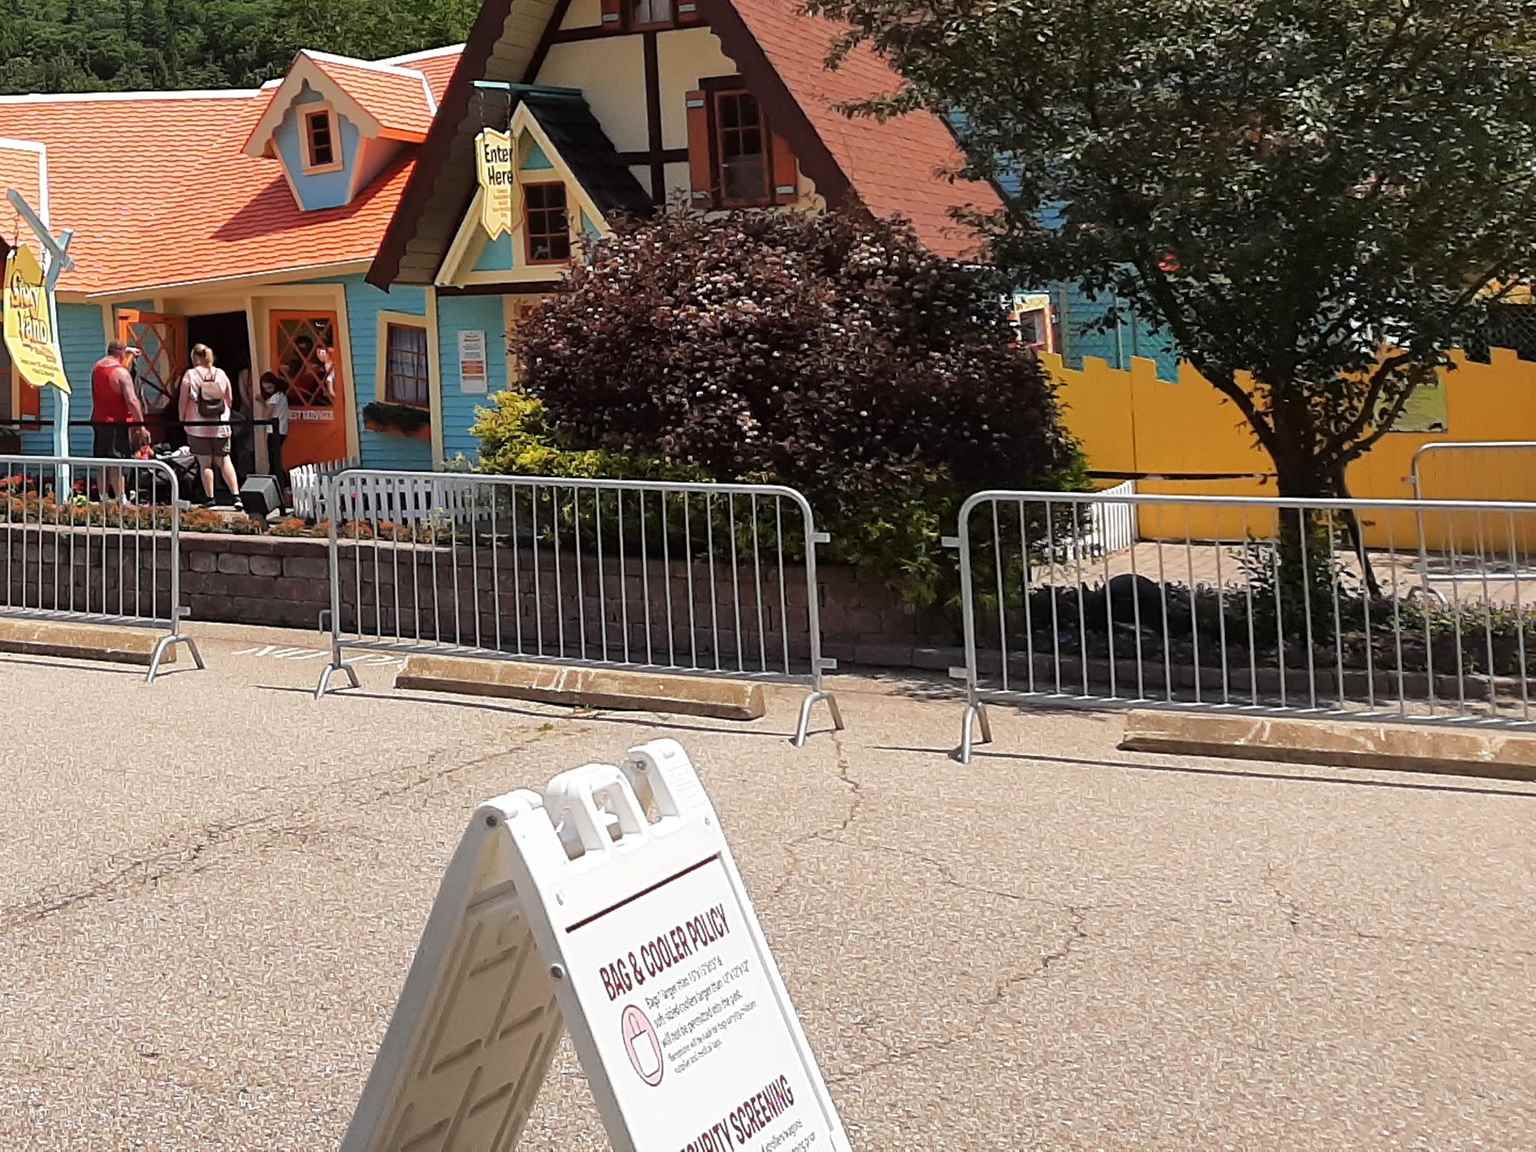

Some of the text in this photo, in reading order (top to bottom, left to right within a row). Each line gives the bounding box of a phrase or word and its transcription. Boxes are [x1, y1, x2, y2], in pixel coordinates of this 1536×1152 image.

[487, 166, 513, 185] Here
[599, 958, 632, 1001] BAG
[628, 951, 645, 985] &
[640, 925, 693, 978] COOLER
[685, 903, 730, 952] POLICY
[730, 1074, 794, 1145] SCREENING
